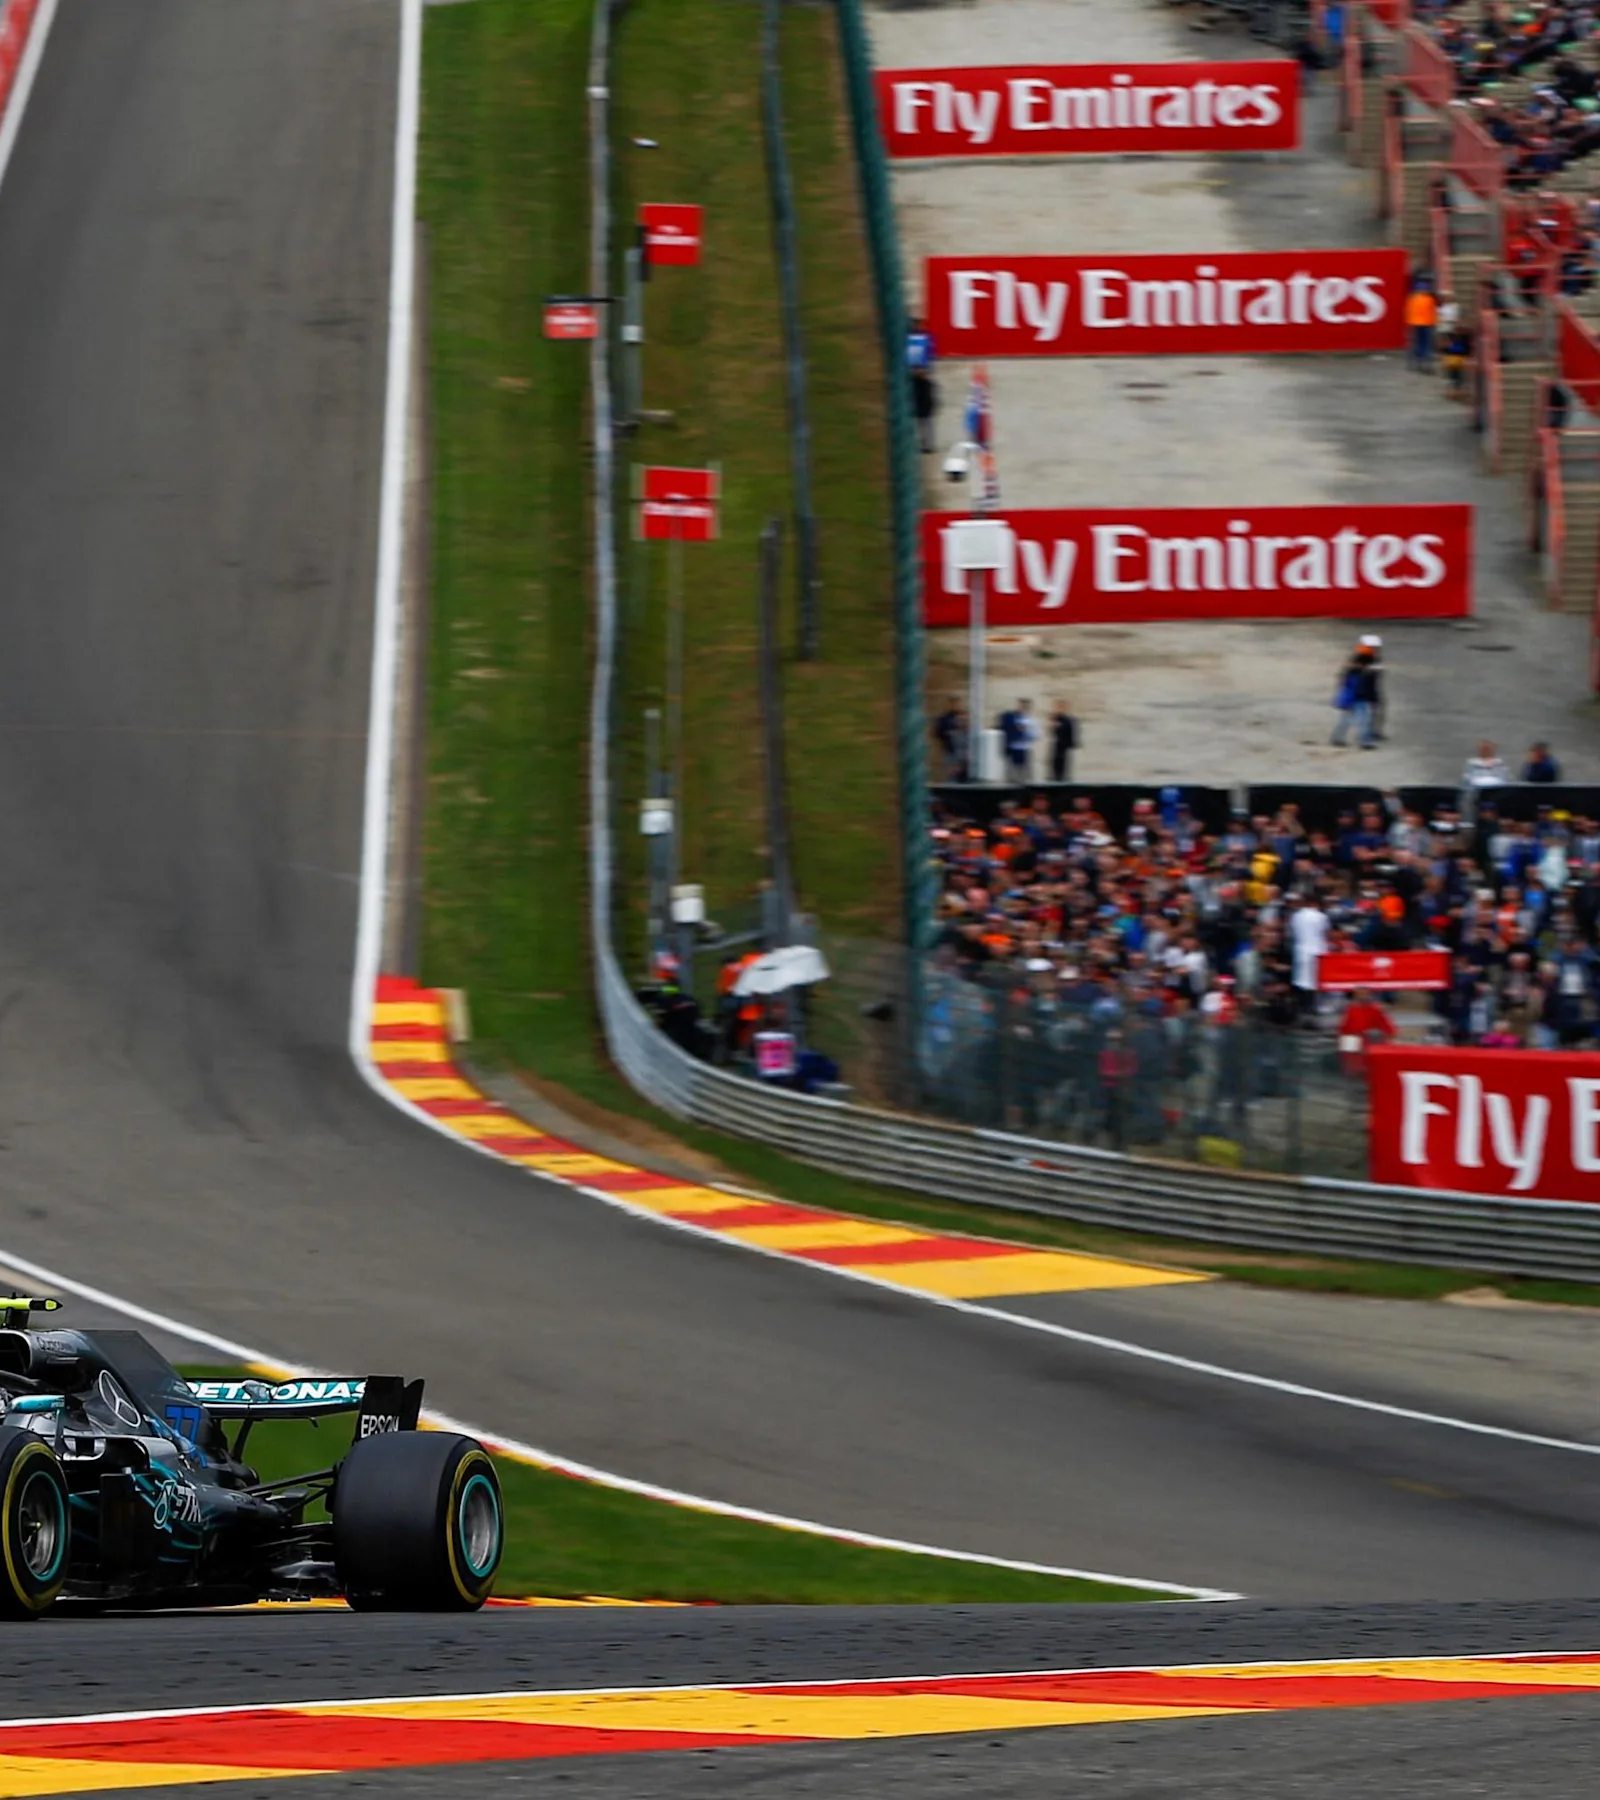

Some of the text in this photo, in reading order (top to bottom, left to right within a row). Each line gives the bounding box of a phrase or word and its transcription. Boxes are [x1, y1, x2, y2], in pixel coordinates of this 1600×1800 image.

[891, 74, 1284, 144] Fly Emirates
[947, 265, 1387, 341] Fly Emirates
[1088, 519, 1446, 592] Emirates
[1397, 1070, 1551, 1191] Fly
[186, 1381, 367, 1401] ETONAS
[361, 1414, 399, 1438] EPSON
